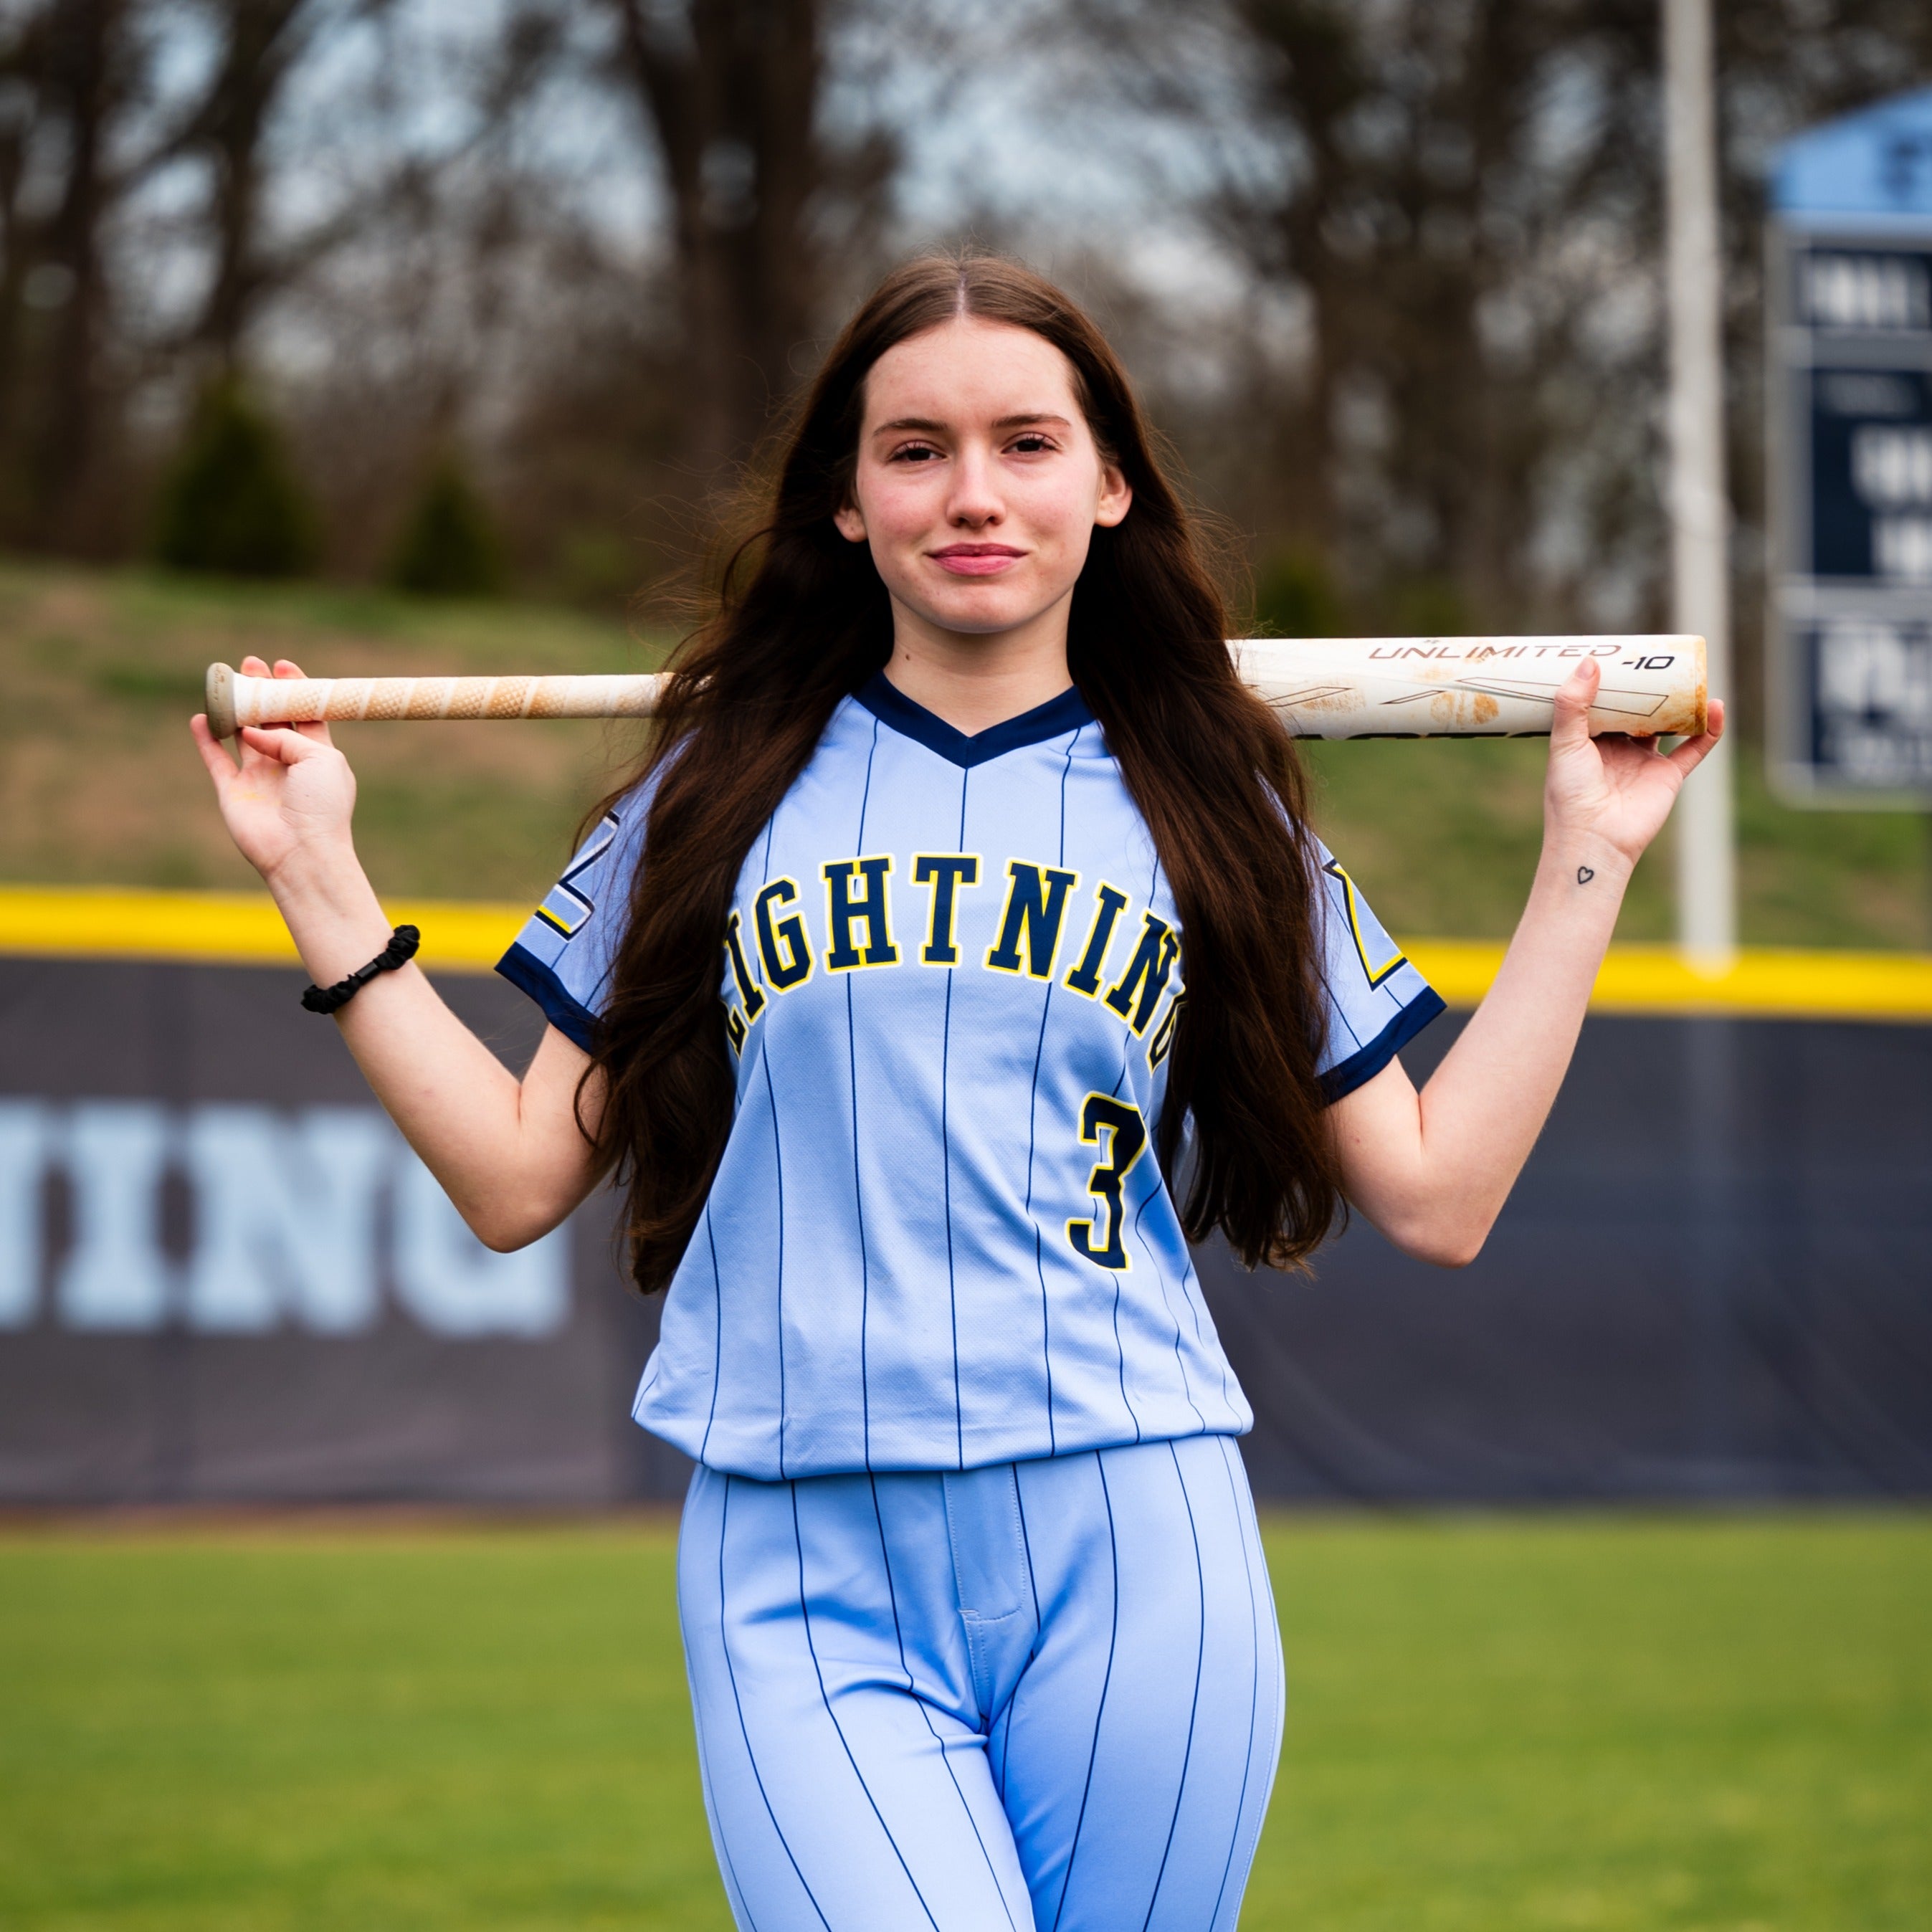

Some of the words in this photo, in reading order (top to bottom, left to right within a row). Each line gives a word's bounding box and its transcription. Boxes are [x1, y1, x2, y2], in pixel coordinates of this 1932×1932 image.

[1369, 644, 1622, 660] UNLIMITED
[1621, 656, 1675, 670] -10
[1065, 1090, 1148, 1272] 3
